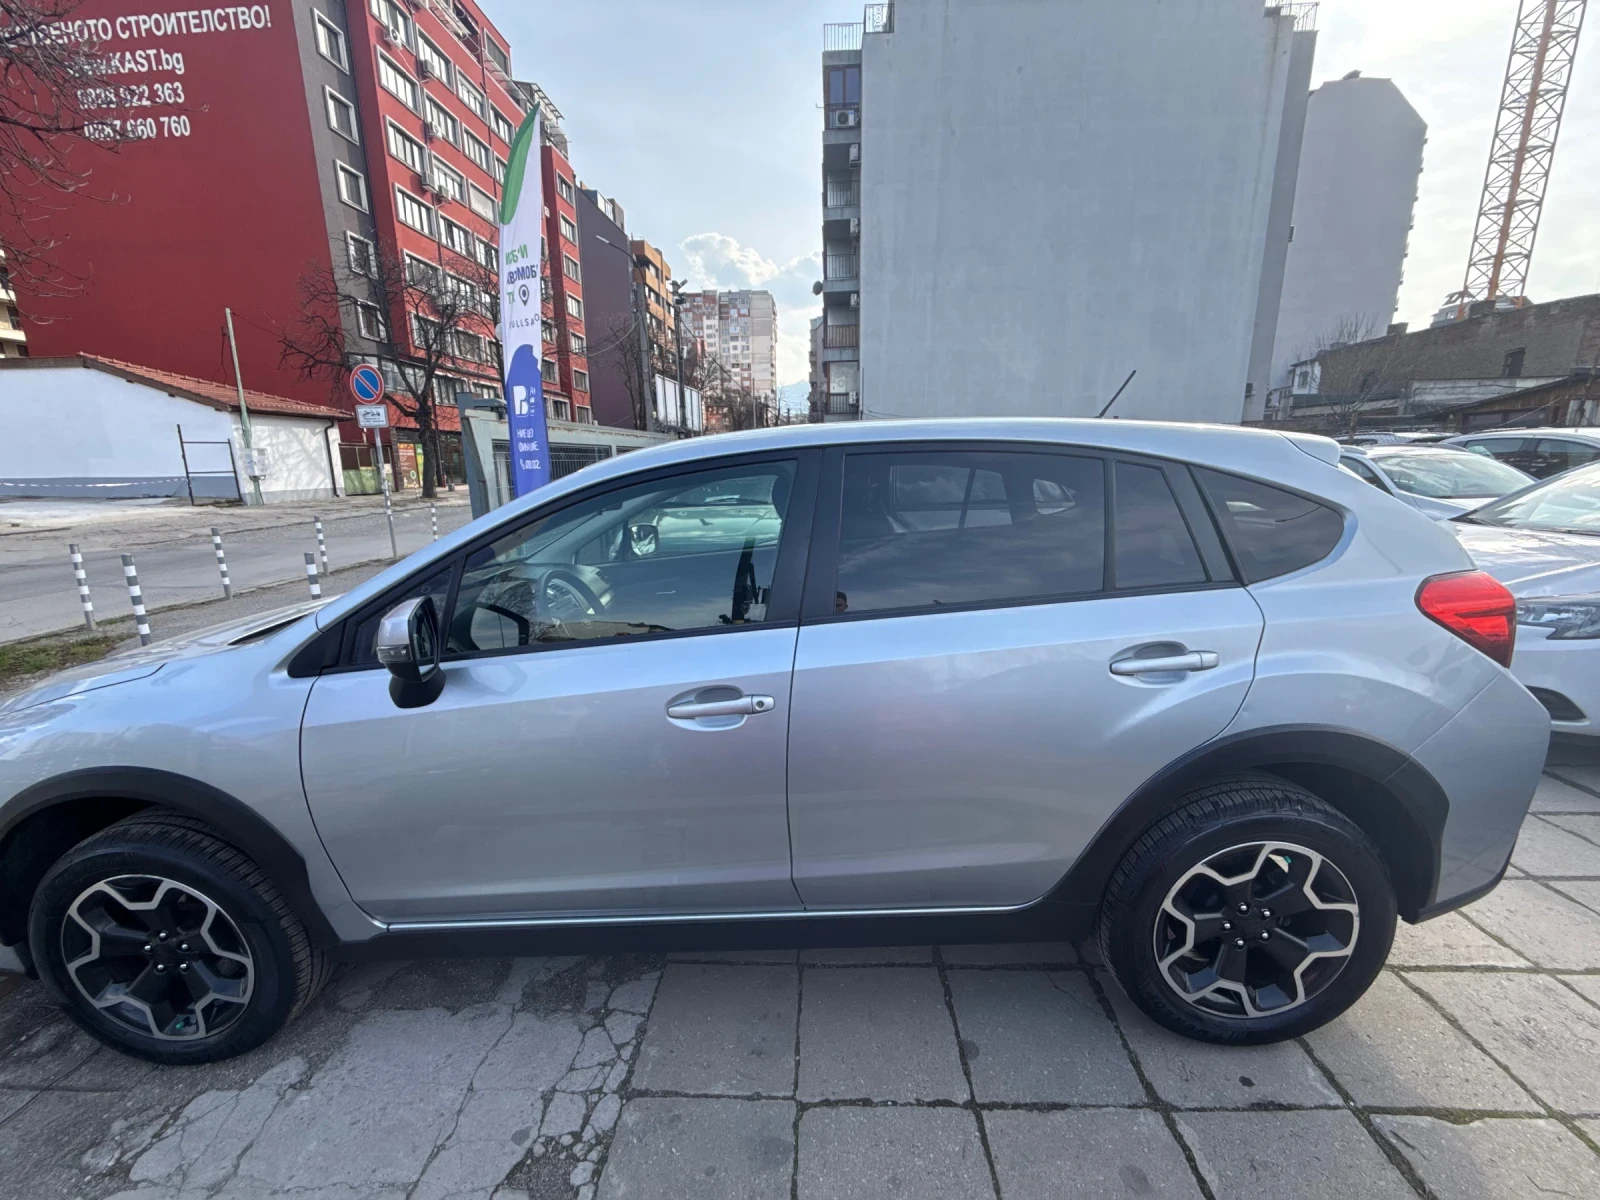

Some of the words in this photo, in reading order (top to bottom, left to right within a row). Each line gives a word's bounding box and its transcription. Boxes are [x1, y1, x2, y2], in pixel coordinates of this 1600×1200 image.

[115, 5, 272, 40] СТРОИТЕЛСТВО!
[153, 82, 185, 104] 363
[159, 115, 191, 137] 760
